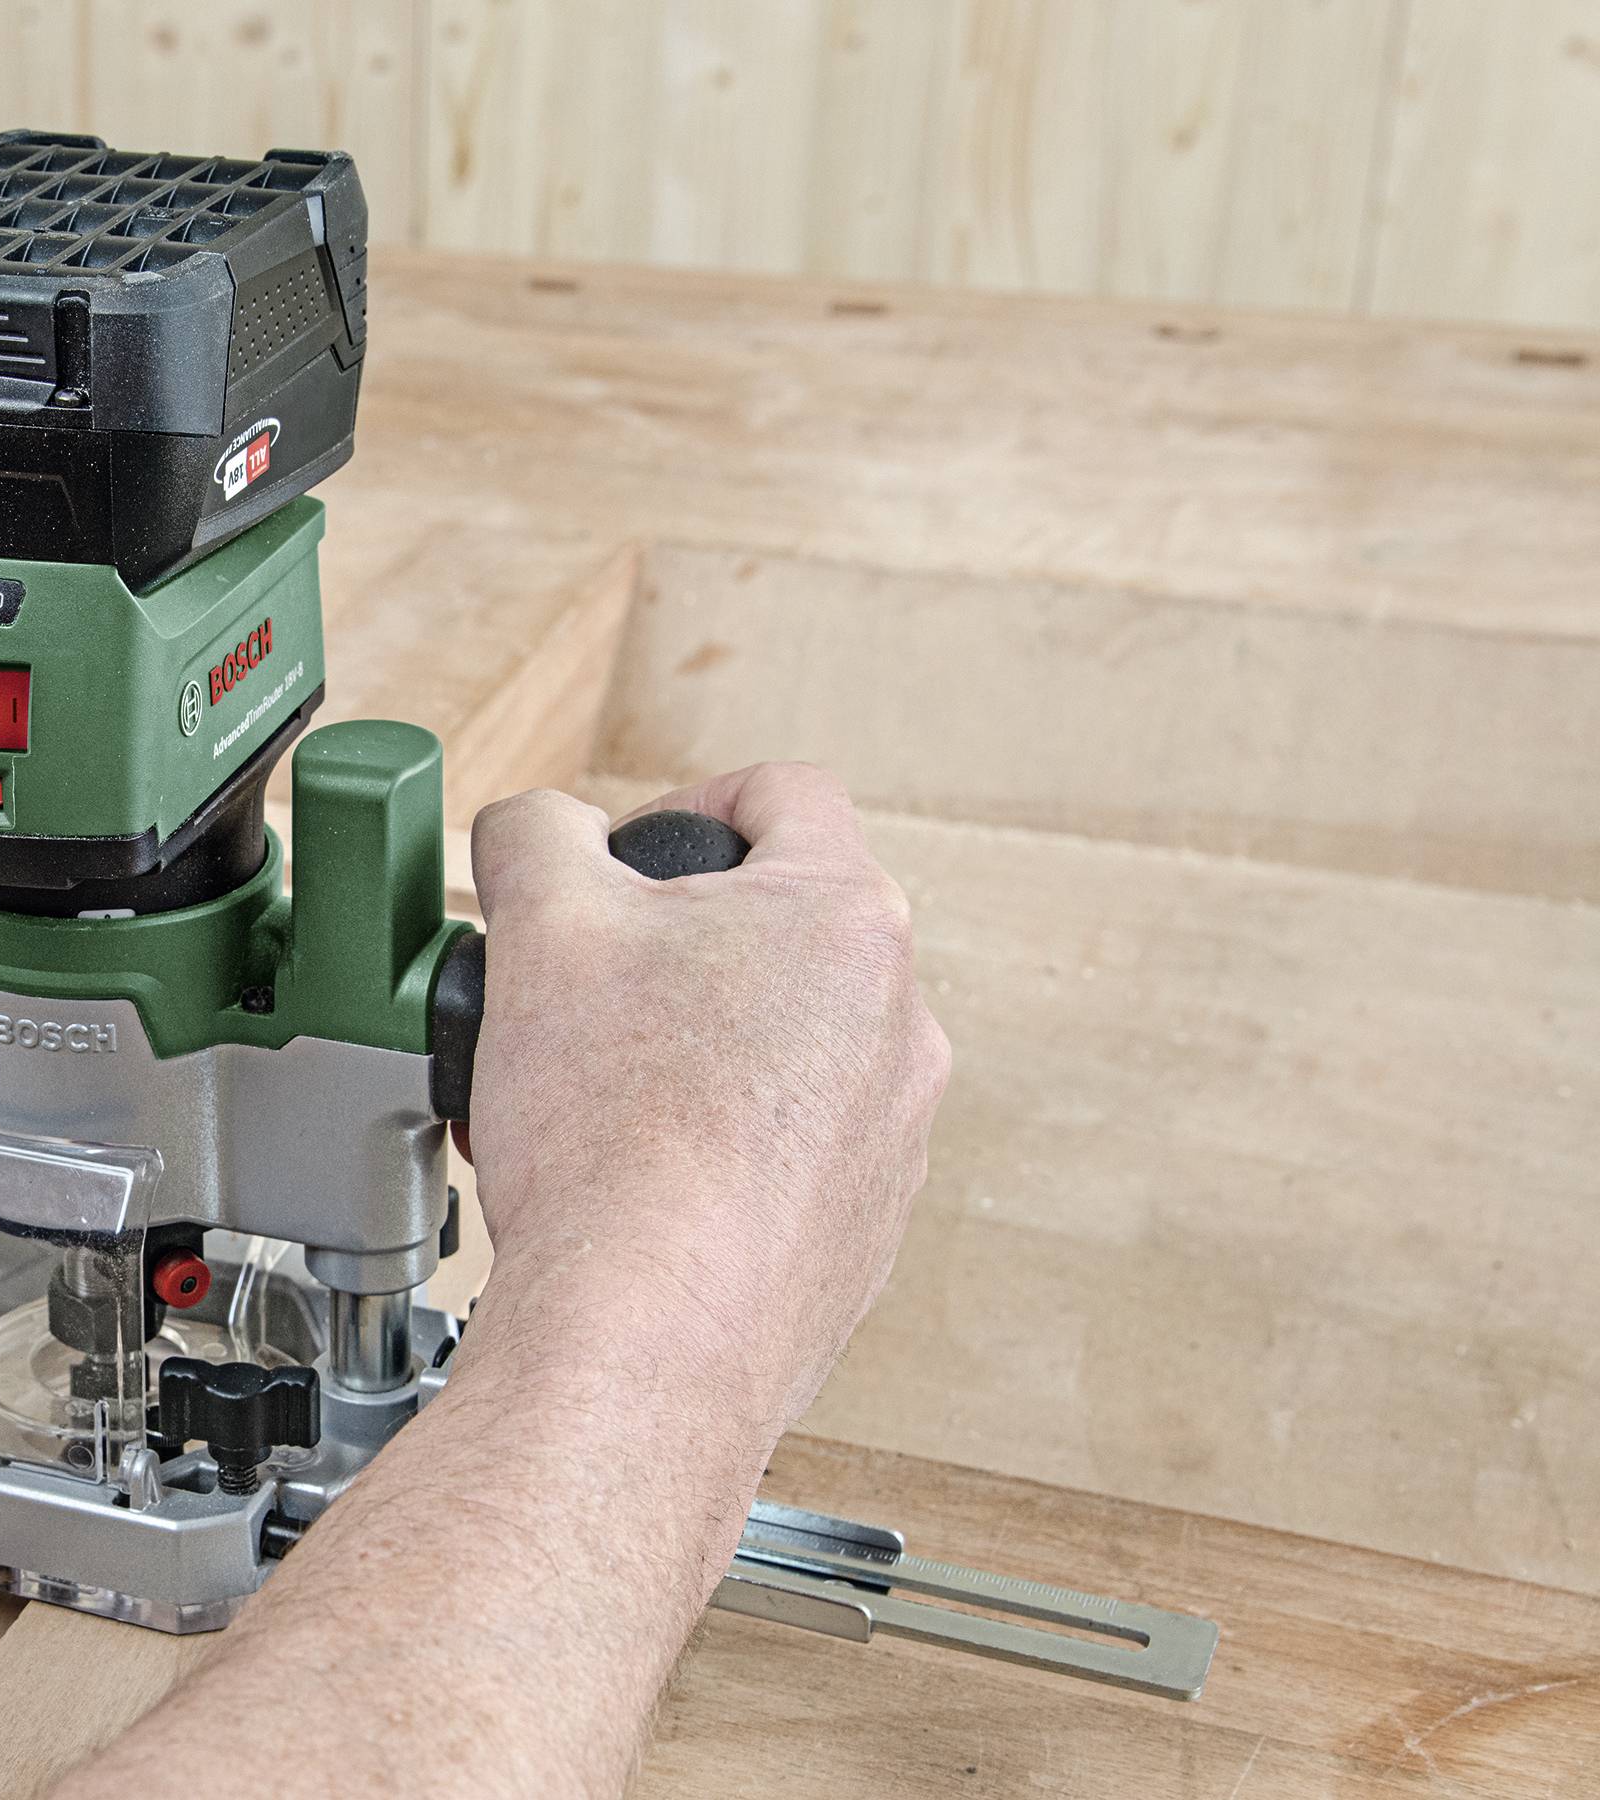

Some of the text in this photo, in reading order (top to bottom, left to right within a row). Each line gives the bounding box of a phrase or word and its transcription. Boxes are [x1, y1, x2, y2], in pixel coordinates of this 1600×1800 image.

[232, 418, 264, 451] ALLIANCE
[249, 444, 267, 470] ALL
[228, 463, 244, 488] 18V
[209, 617, 273, 706] BOSCH
[213, 661, 304, 760] AdvancedTrimRouter 18V-8
